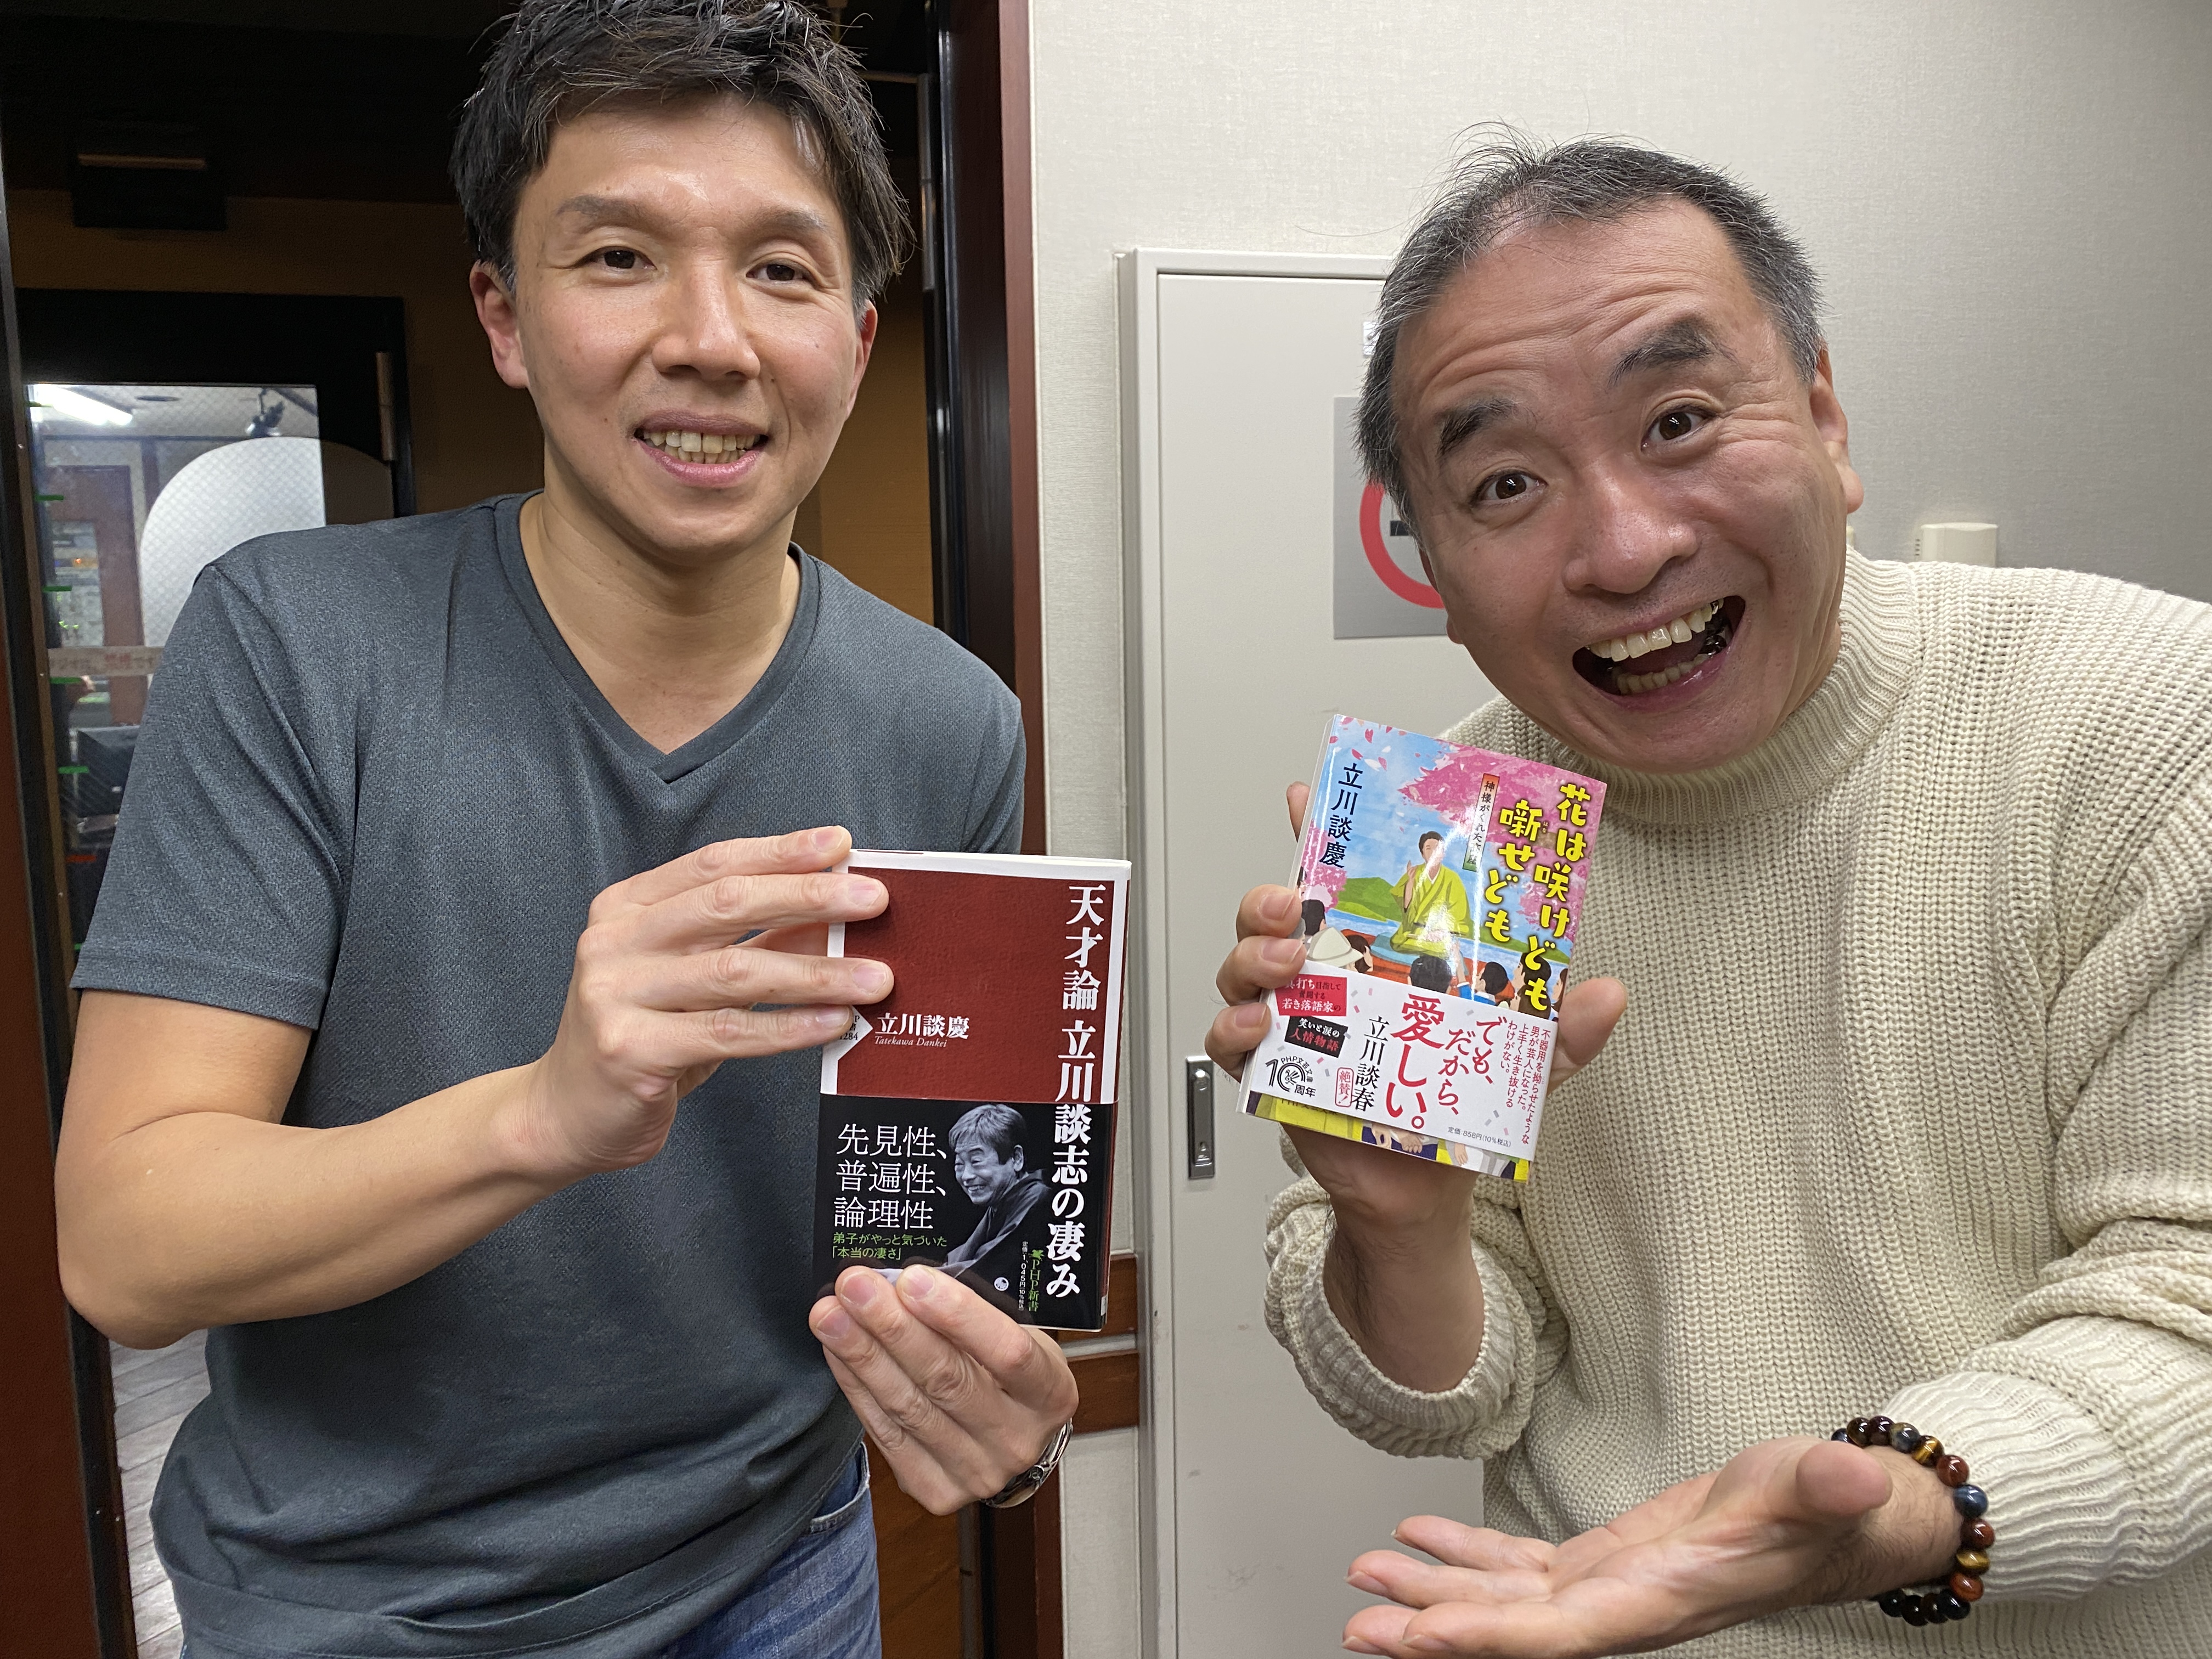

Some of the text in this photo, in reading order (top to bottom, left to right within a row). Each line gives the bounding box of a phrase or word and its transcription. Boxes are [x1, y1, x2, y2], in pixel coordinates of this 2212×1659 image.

[1318, 763, 1363, 868] 立川談慶
[1485, 799, 1543, 943] 噺せども
[1525, 783, 1591, 1011] 花は咲けども
[875, 1012, 970, 1039] 立川談慶
[1282, 998, 1341, 1013] 若き落語家の
[1297, 1017, 1340, 1037] 笑いと涙の
[874, 1035, 947, 1047] Tatekawa Dankei
[1290, 1028, 1339, 1051] 人情物語
[1351, 1015, 1390, 1111] 立川談春
[1386, 994, 1444, 1129] 愛しい。
[1472, 1016, 1507, 1085] でも、
[1500, 1020, 1517, 1074] わけがない。
[1506, 1023, 1529, 1108] 上手く生き抜ける
[1046, 884, 1107, 1298] 天才論 立川談志の凄み
[1438, 1029, 1476, 1115] だから、
[1517, 1026, 1540, 1110] 男が芸人になった。
[1521, 1029, 1551, 1144] 不器用を拗らせたような
[836, 1124, 947, 1159] 先見性、
[836, 1159, 946, 1197] 普遍性、
[833, 1197, 933, 1230] 論理性
[833, 1232, 947, 1247] 弟子がやっと気づいた
[832, 1245, 901, 1260] 「本当の凄さ」
[1028, 1259, 1041, 1312] PHP新書
